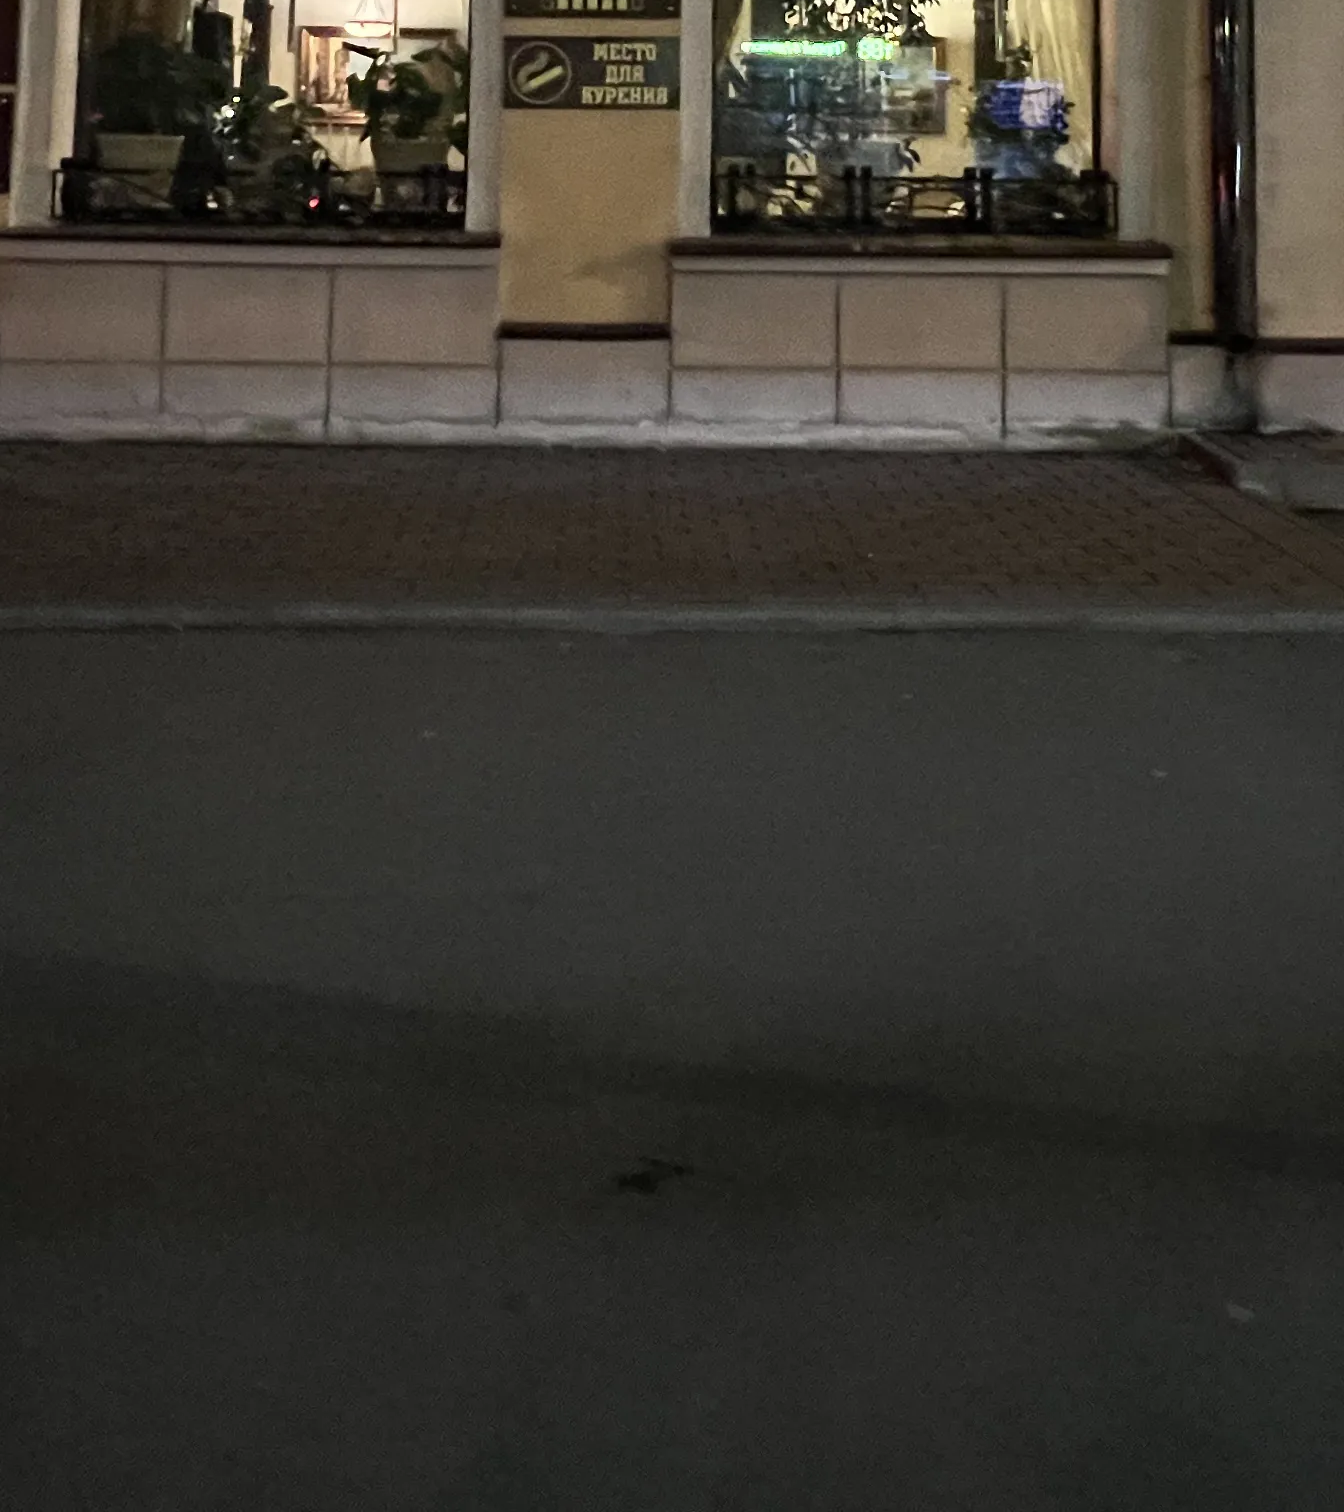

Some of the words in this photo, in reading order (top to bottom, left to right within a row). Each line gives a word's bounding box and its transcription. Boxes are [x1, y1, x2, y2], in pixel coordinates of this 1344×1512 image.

[593, 42, 657, 62] МЕСТО
[605, 64, 645, 84] ДЛЯ
[581, 85, 669, 105] КУРЕНИЯ
